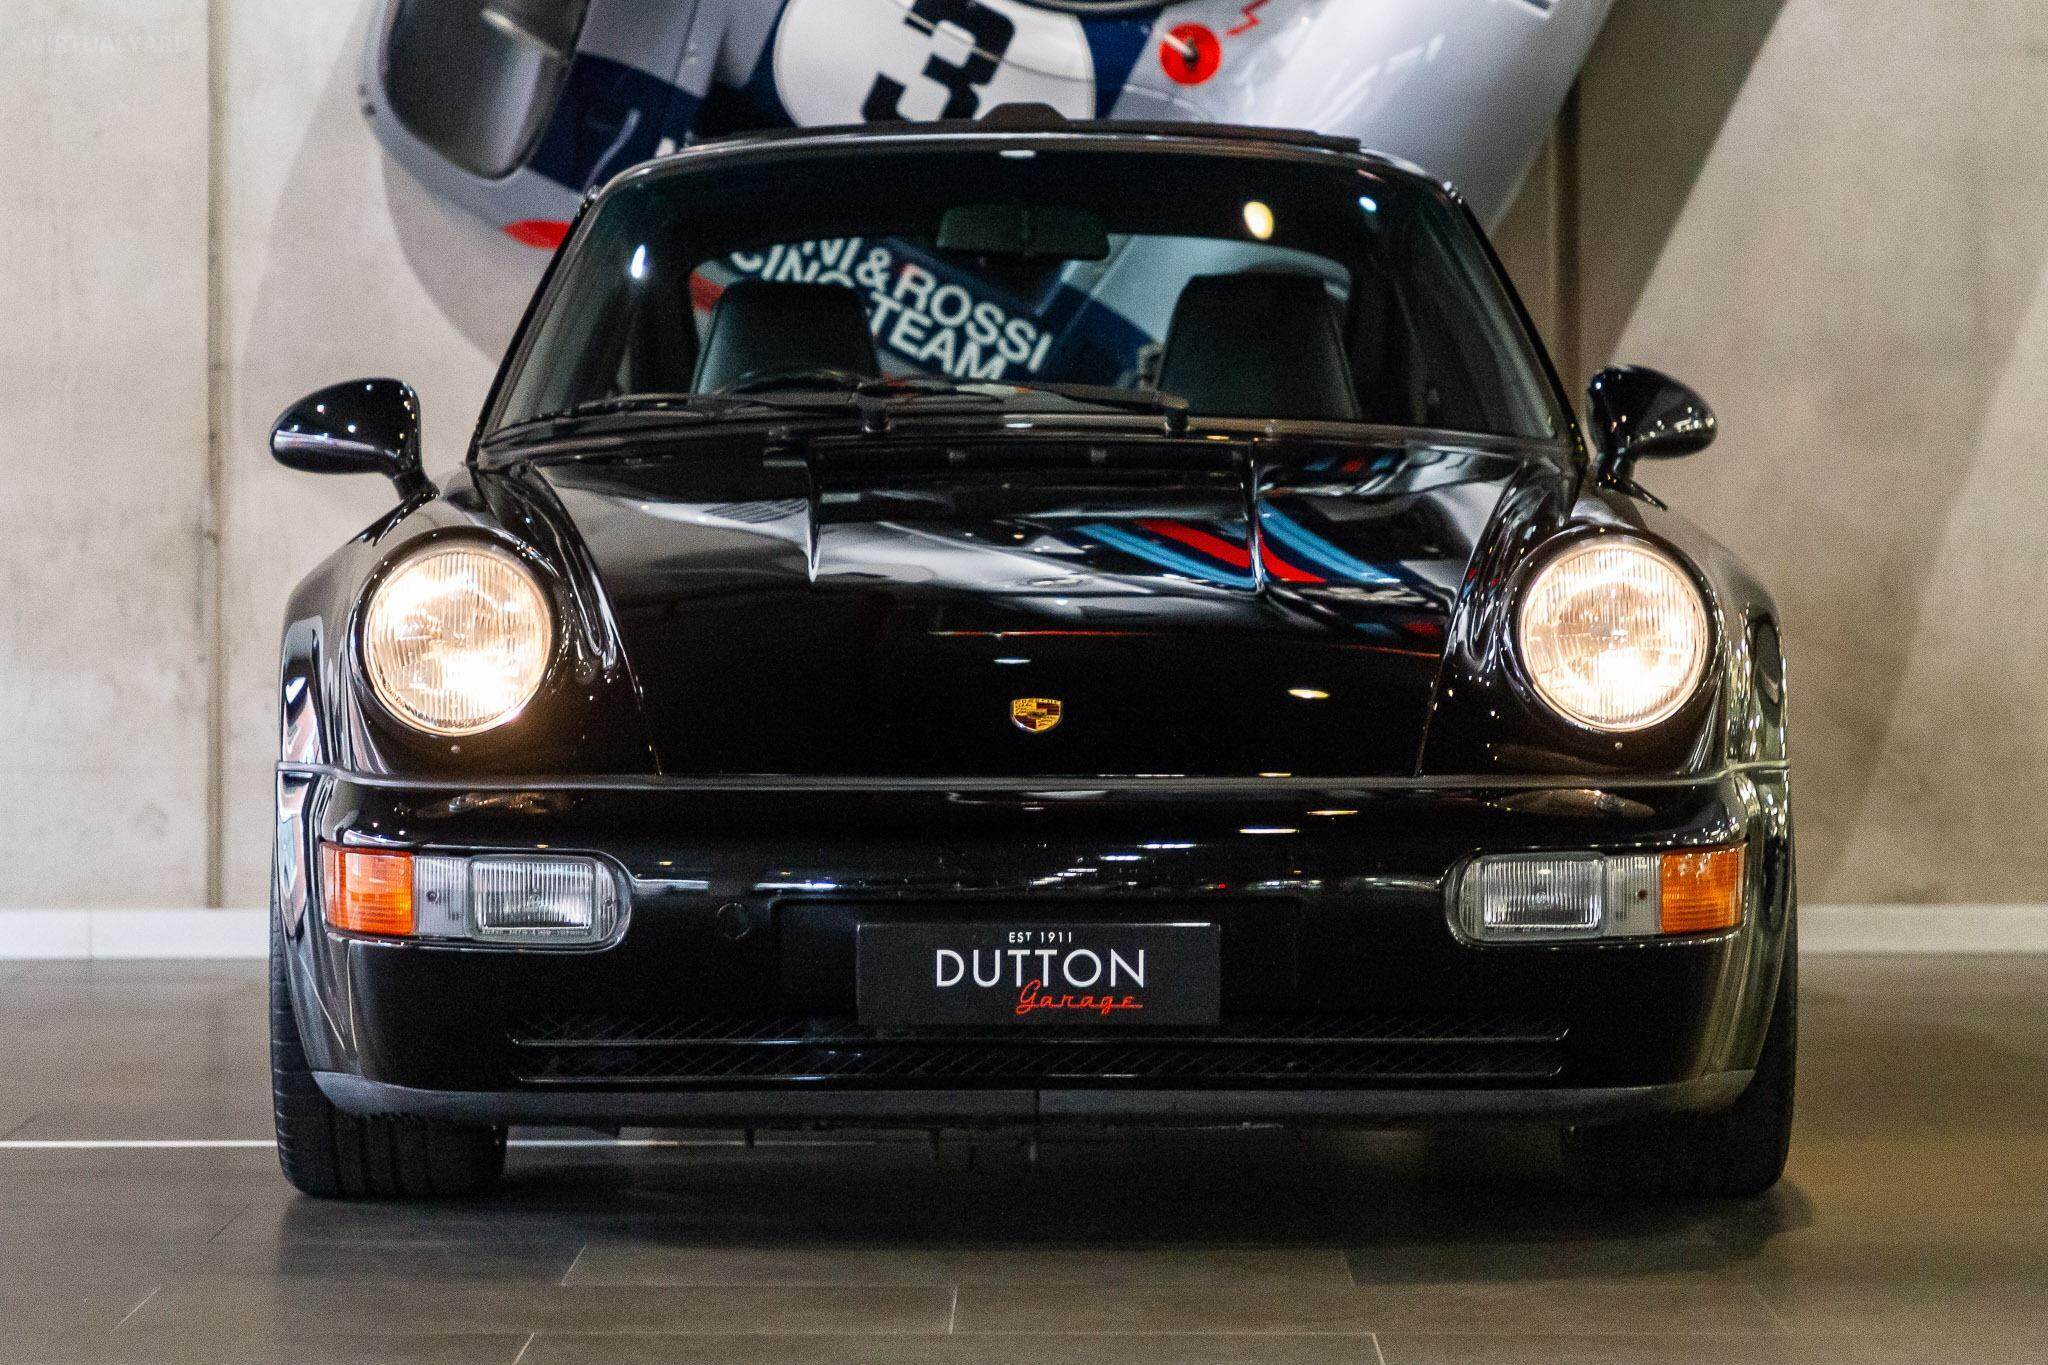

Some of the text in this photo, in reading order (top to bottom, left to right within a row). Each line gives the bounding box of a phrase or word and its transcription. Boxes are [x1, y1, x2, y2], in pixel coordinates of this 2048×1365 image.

[861, 0, 1015, 121] 3
[855, 248, 891, 292] &
[893, 262, 1053, 373] ROSSI
[868, 290, 1006, 380] TEAM
[936, 948, 1144, 988] DUTTON
[1008, 931, 1072, 943] EST 1911
[1015, 979, 1143, 1015] Garage
